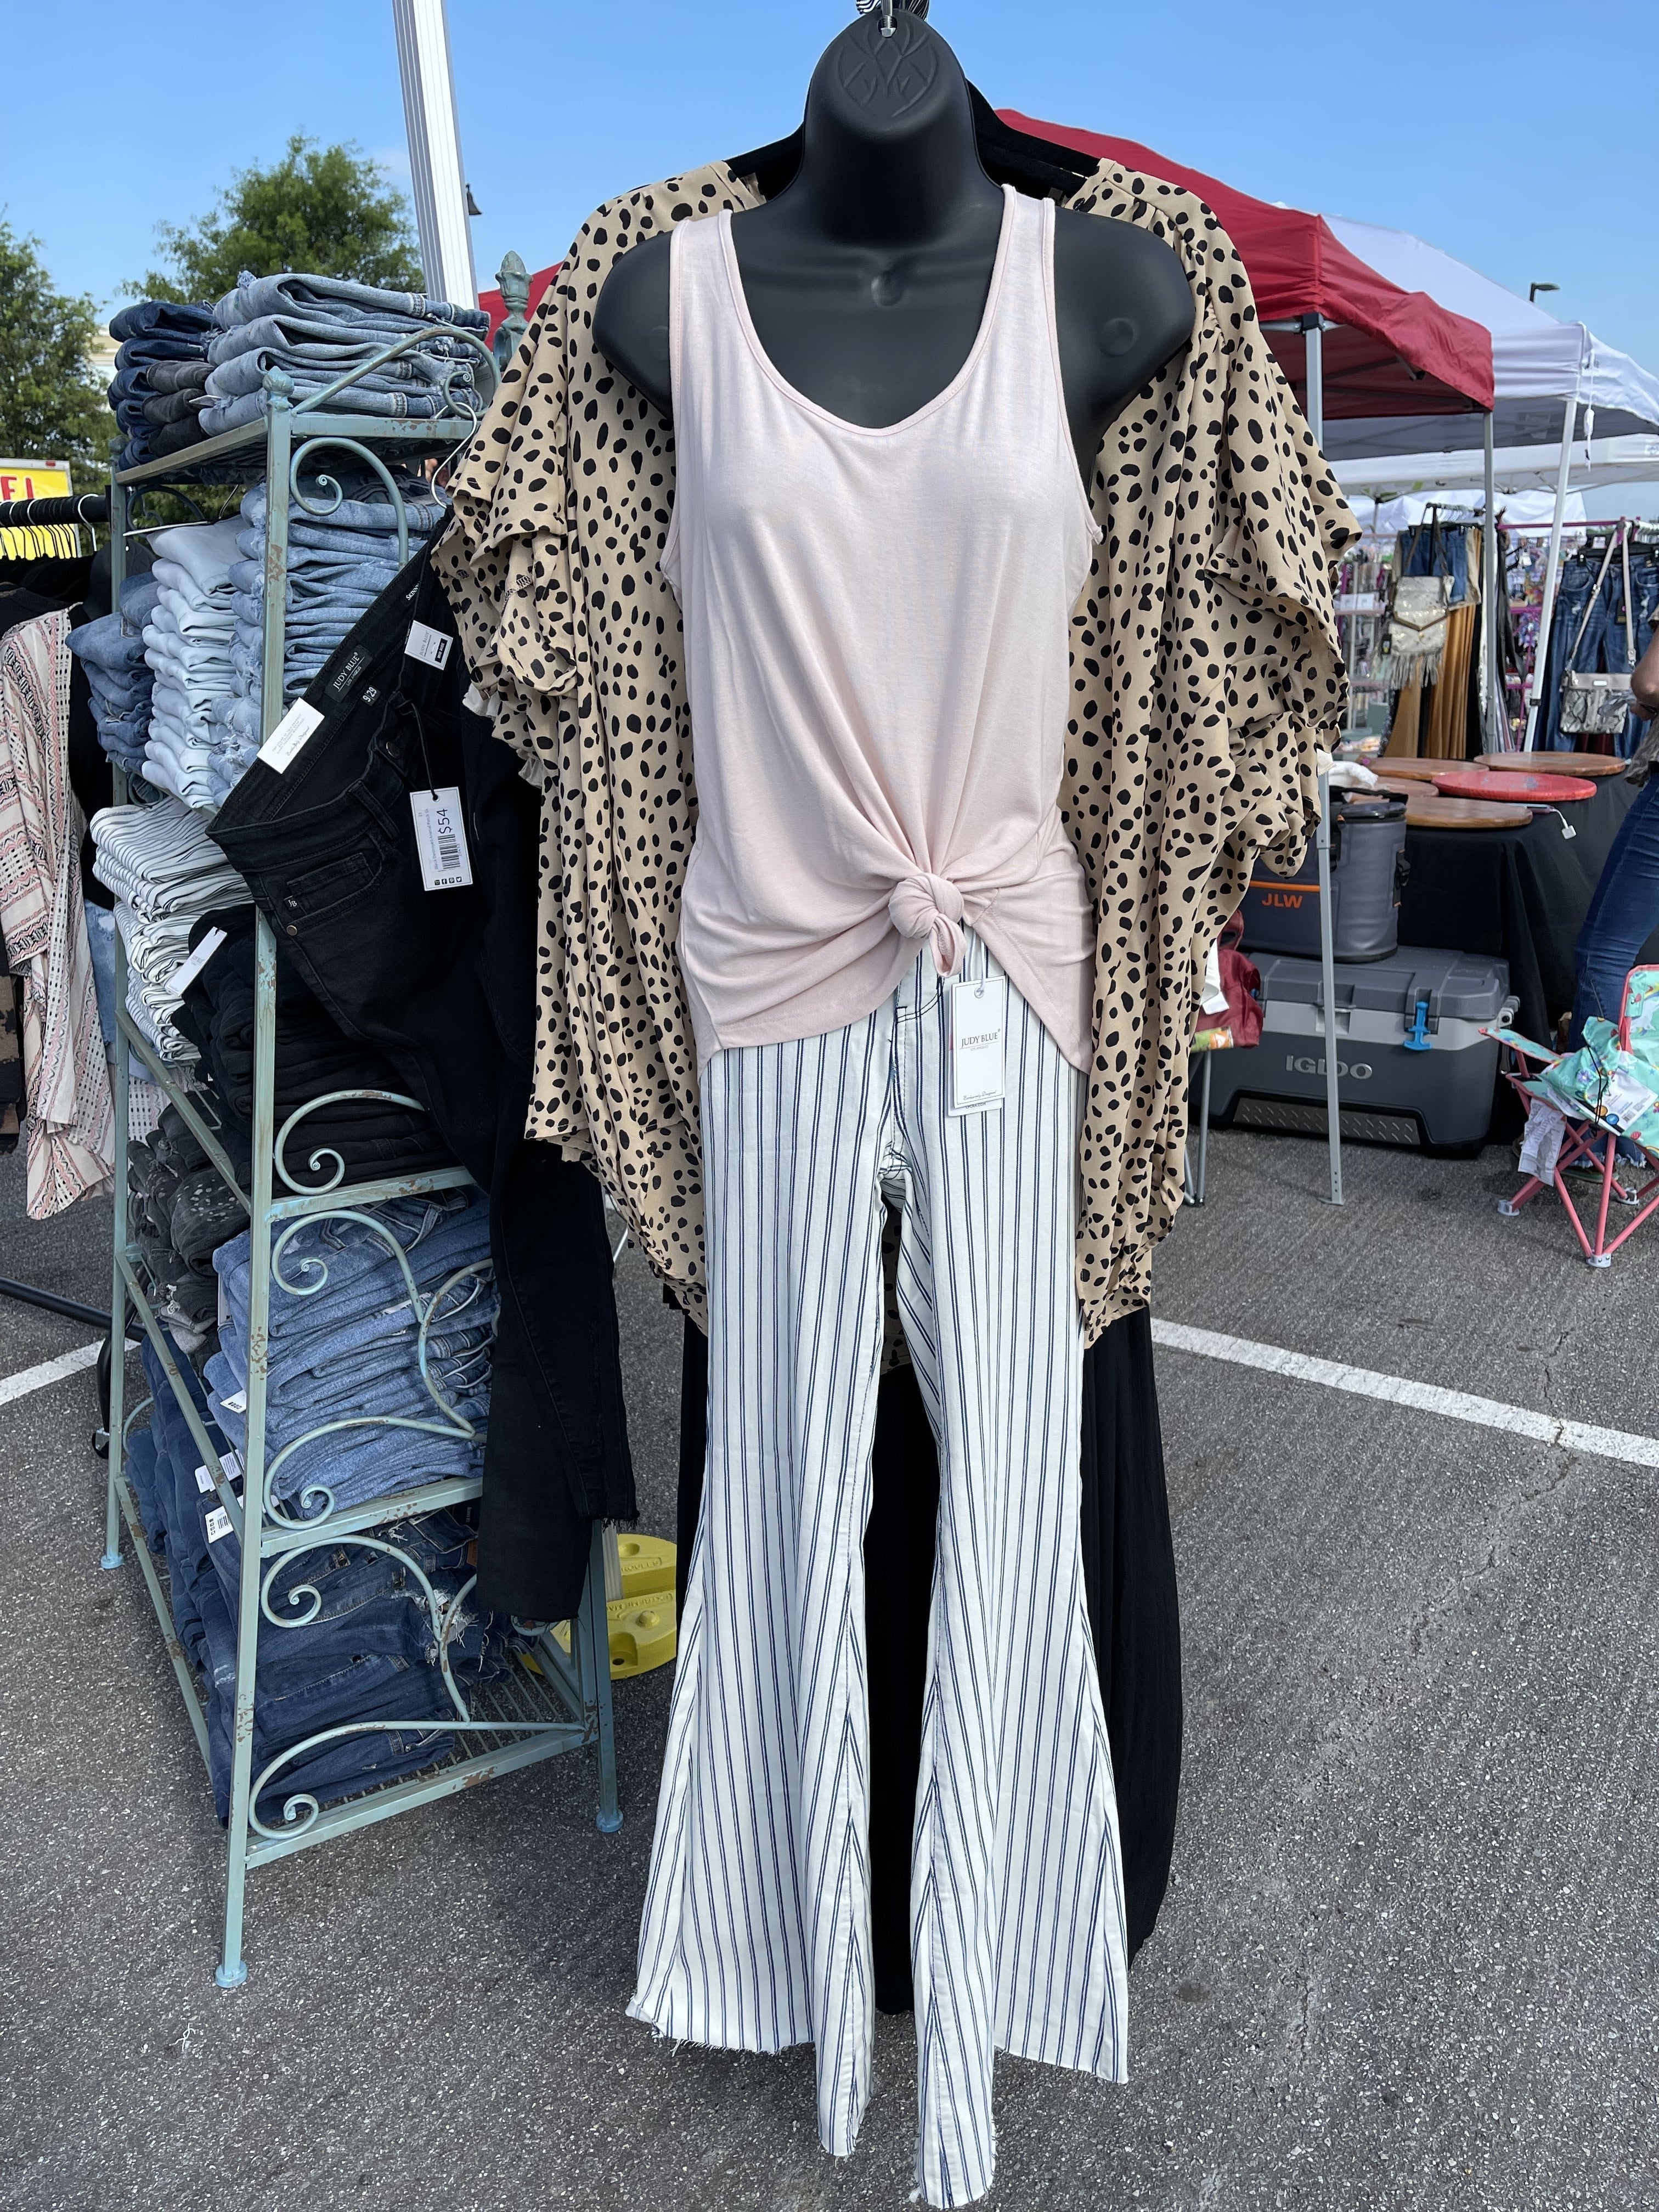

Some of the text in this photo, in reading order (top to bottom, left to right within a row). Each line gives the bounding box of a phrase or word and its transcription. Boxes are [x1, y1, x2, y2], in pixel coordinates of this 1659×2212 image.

[333, 669, 347, 690] JUDY
[437, 809, 453, 834] $54
[1262, 893, 1303, 909] JLW
[961, 1036, 980, 1048] JUDY
[1285, 1055, 1372, 1080] IGLOO
